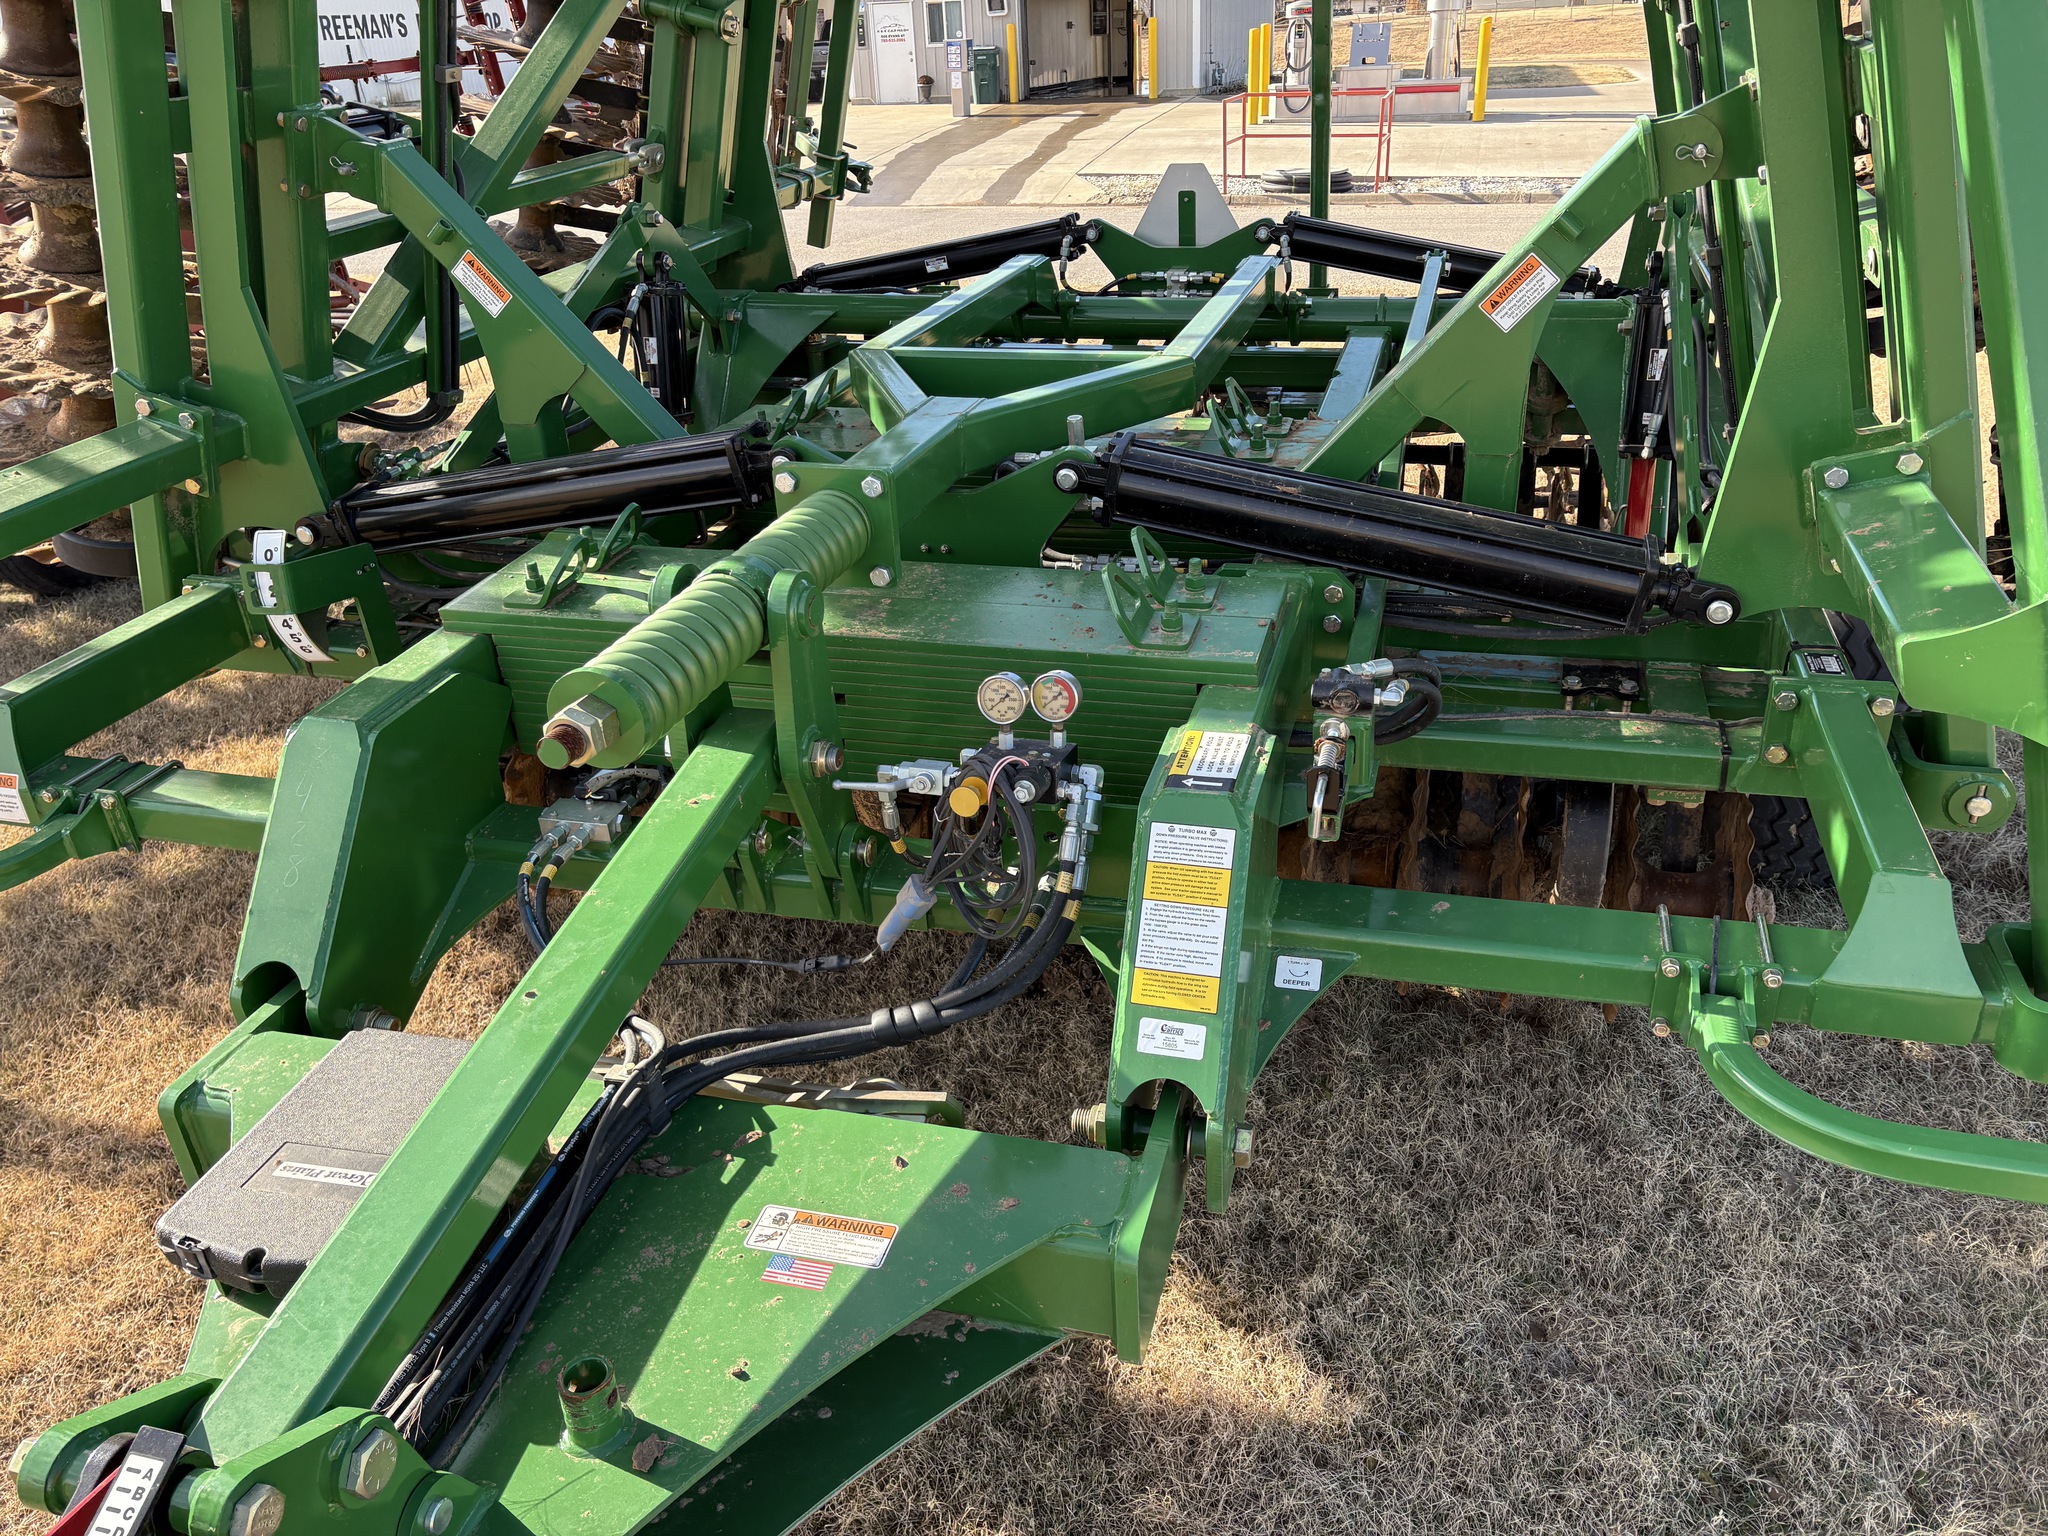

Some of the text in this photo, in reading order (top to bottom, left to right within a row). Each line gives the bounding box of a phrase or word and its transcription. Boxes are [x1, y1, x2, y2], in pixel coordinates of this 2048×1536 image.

[474, 264, 505, 298] WARNING
[1495, 261, 1535, 300] WARNING
[1516, 285, 1525, 295] FALL
[1174, 735, 1196, 768] ATTENTION:
[1195, 736, 1214, 771] SECONDARY FOLD
[1205, 736, 1224, 772] LOCK VALVE MUST
[1218, 754, 1228, 765] OPEN
[1225, 736, 1234, 746] FOLD
[1228, 750, 1239, 766] UNFOLD
[1282, 978, 1310, 986] DEEPER
[280, 1165, 366, 1183] Great Plains
[509, 1209, 526, 1228] POWERING
[814, 1216, 885, 1235] WARNING
[810, 1227, 841, 1235] PRESSURE
[432, 1314, 449, 1333] Flame
[443, 1292, 466, 1317] Resistant
[461, 1278, 476, 1295] MSHA
[395, 1369, 407, 1382] ISO
[414, 1341, 429, 1357] Type
[142, 1468, 154, 1482] A
[131, 1486, 146, 1501] B
[122, 1507, 136, 1521] C
